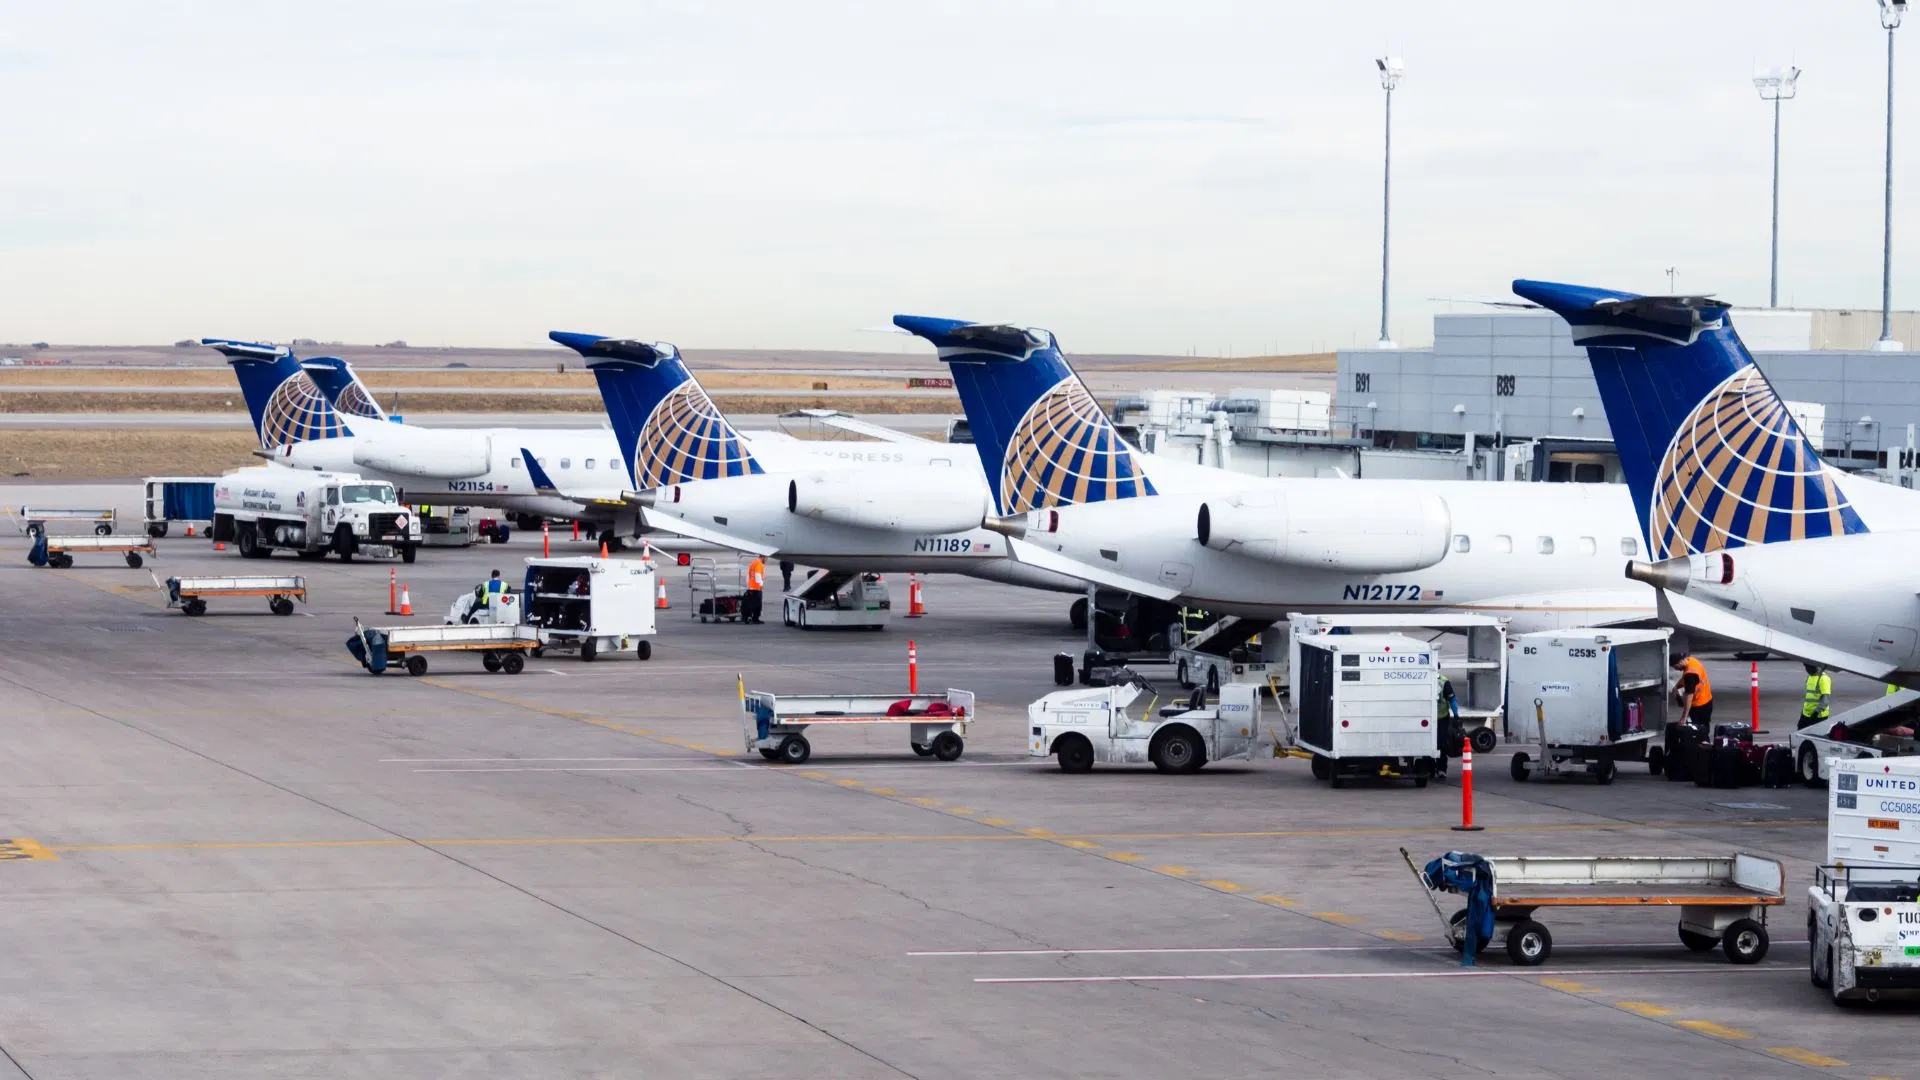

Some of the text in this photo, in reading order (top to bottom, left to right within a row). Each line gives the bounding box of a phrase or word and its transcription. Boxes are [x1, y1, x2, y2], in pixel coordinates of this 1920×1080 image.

[1355, 373, 1370, 393] B91
[1496, 375, 1516, 396] B89
[809, 451, 904, 462] PRESS
[448, 481, 494, 491] N21154
[914, 538, 971, 552] N11189
[1343, 584, 1421, 600] N12172
[1523, 647, 1537, 655] BC
[1568, 648, 1597, 658] C2535
[1383, 671, 1428, 680] BC506227
[1866, 778, 1916, 790] UNITED
